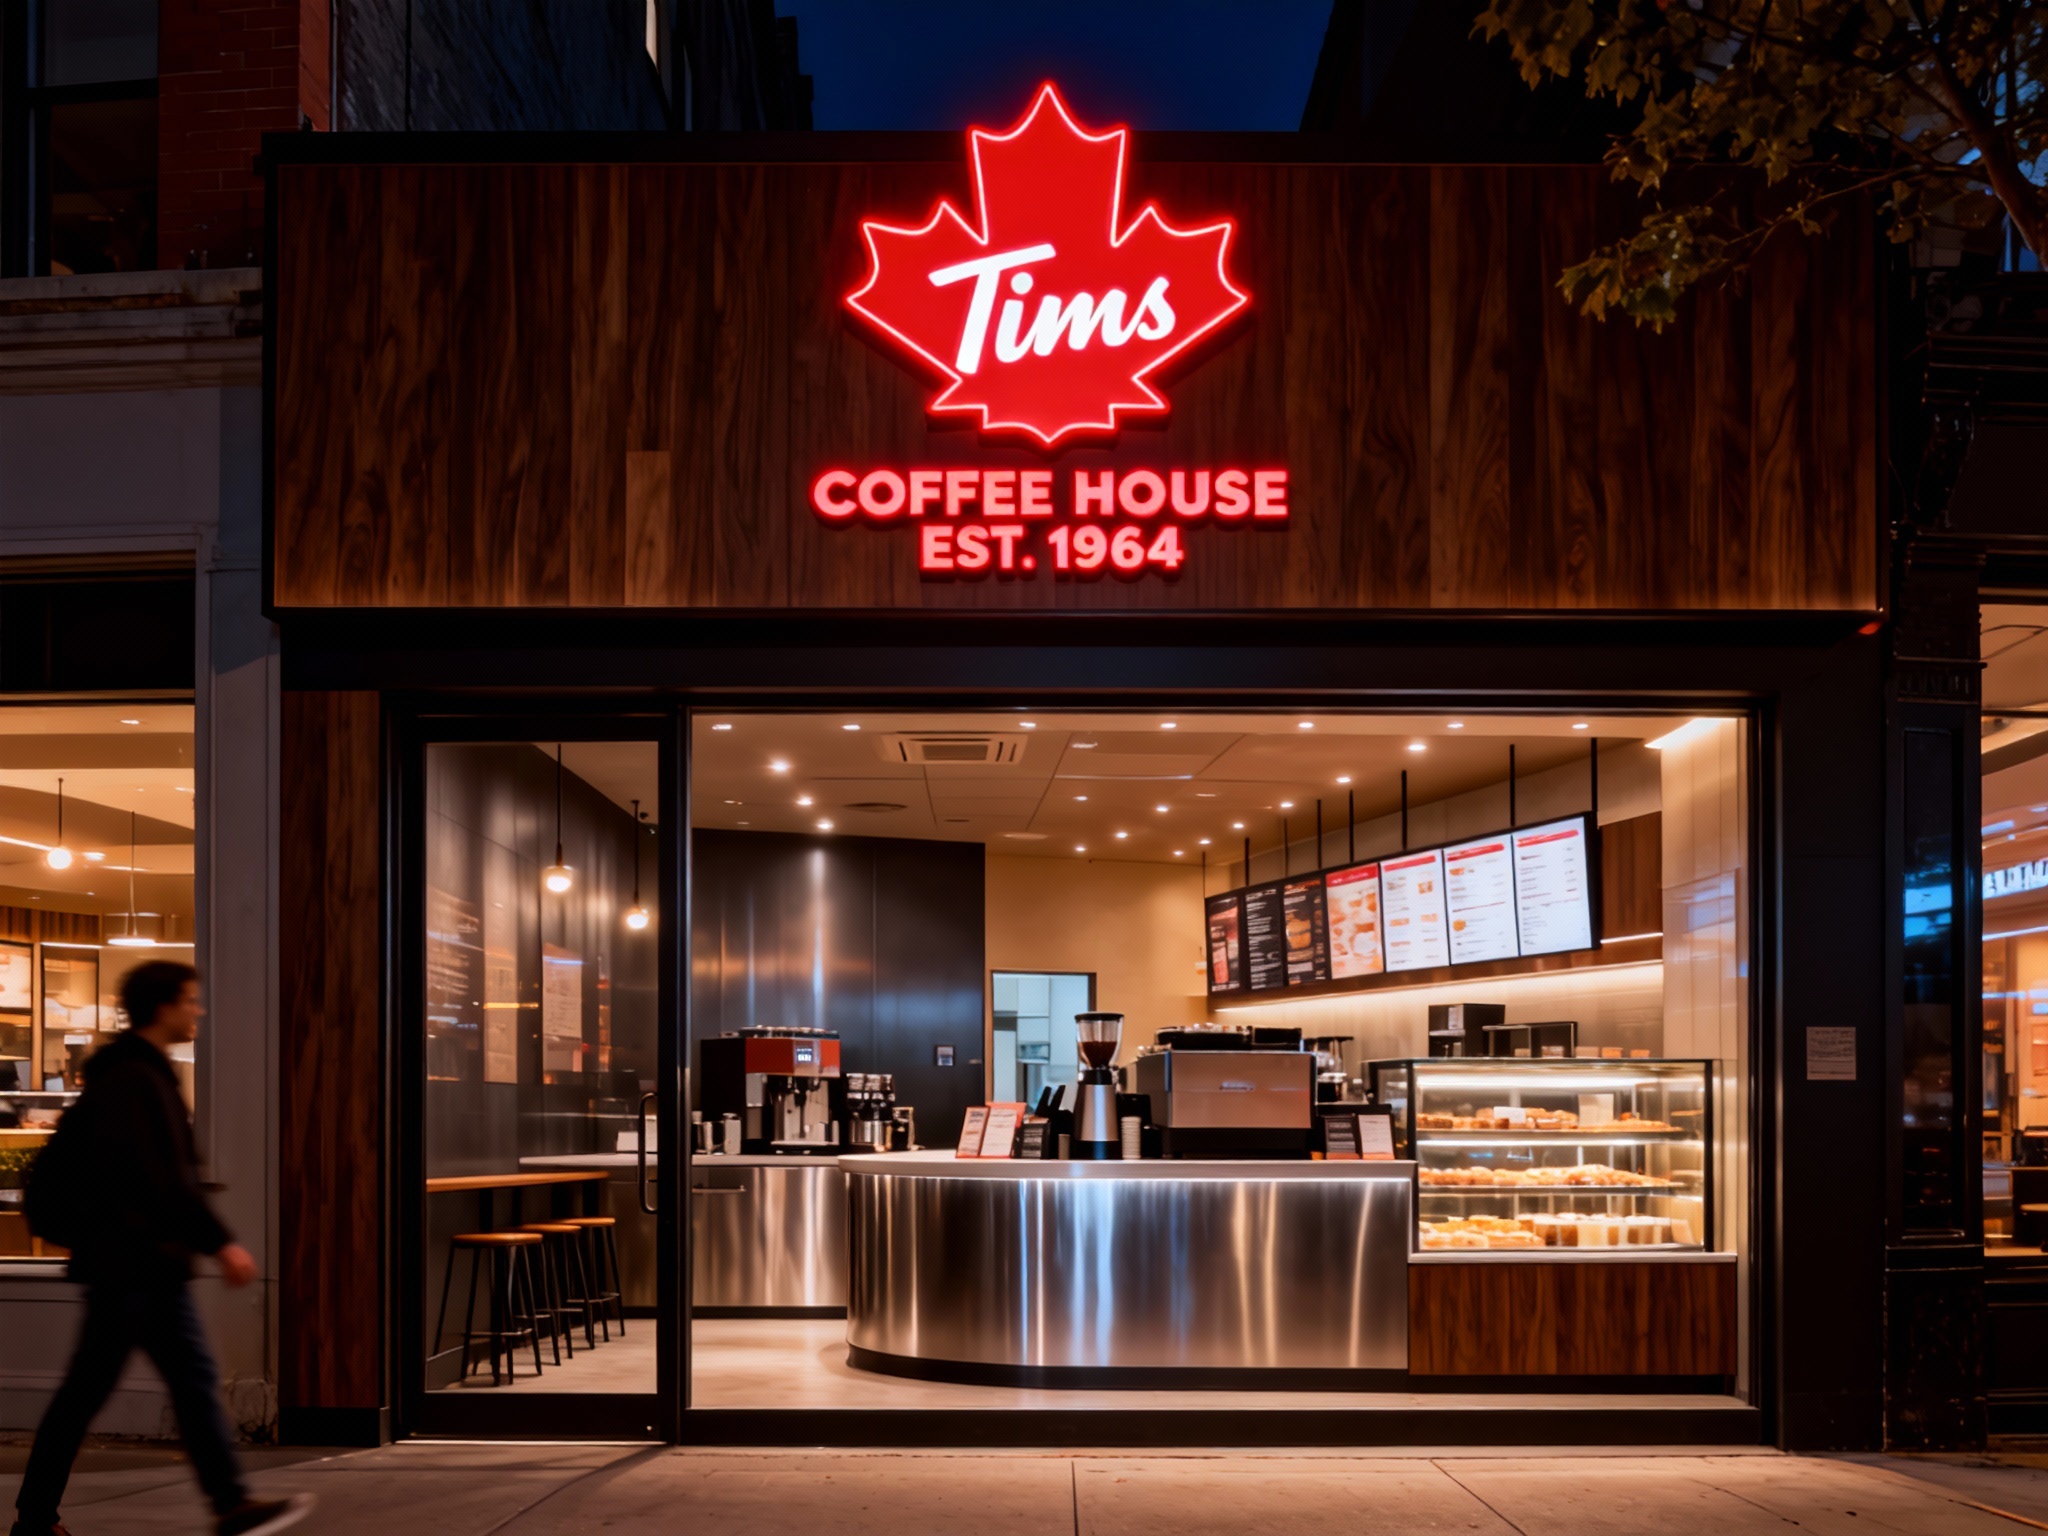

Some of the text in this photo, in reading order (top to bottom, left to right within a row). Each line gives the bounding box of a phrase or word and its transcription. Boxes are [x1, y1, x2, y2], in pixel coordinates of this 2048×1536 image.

[928, 243, 1175, 374] Tims
[813, 470, 1287, 516] COFFEE HOUSE
[922, 526, 1184, 569] EST. 1964
